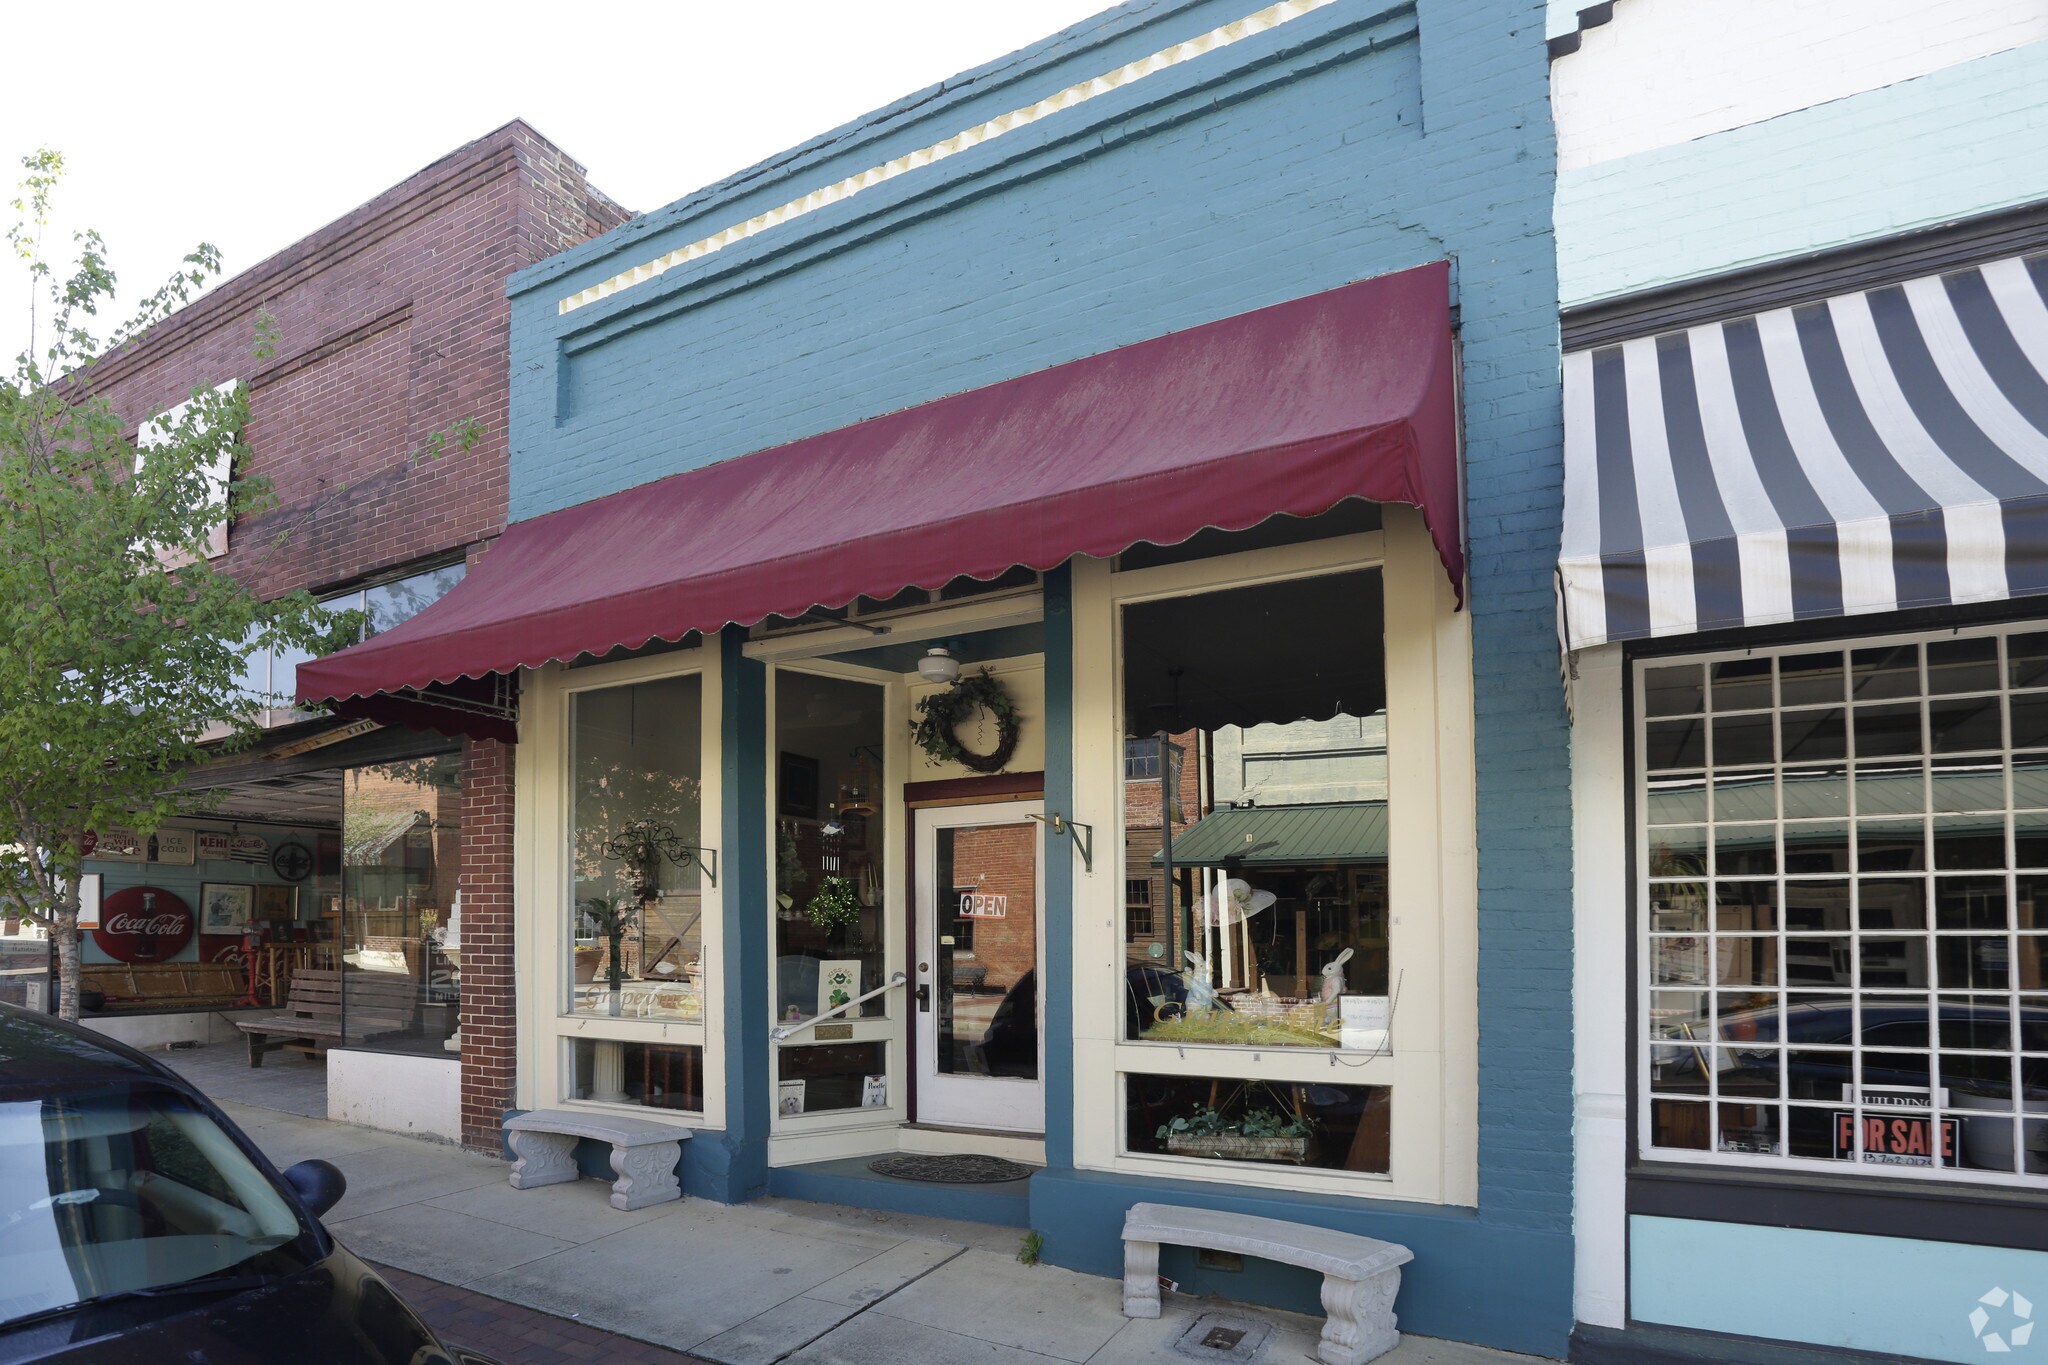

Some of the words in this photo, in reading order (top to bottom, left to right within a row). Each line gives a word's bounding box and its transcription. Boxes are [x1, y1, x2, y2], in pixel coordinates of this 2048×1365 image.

[103, 841, 141, 856] Coe
[114, 837, 138, 847] with
[160, 845, 188, 853] COLD
[200, 837, 226, 848] NEHI
[961, 895, 1006, 915] OPEN
[105, 912, 188, 935] Coca-Cola
[827, 967, 843, 978] KISS
[585, 984, 689, 1011] Grapevine
[1153, 1001, 1345, 1036] Grapevine
